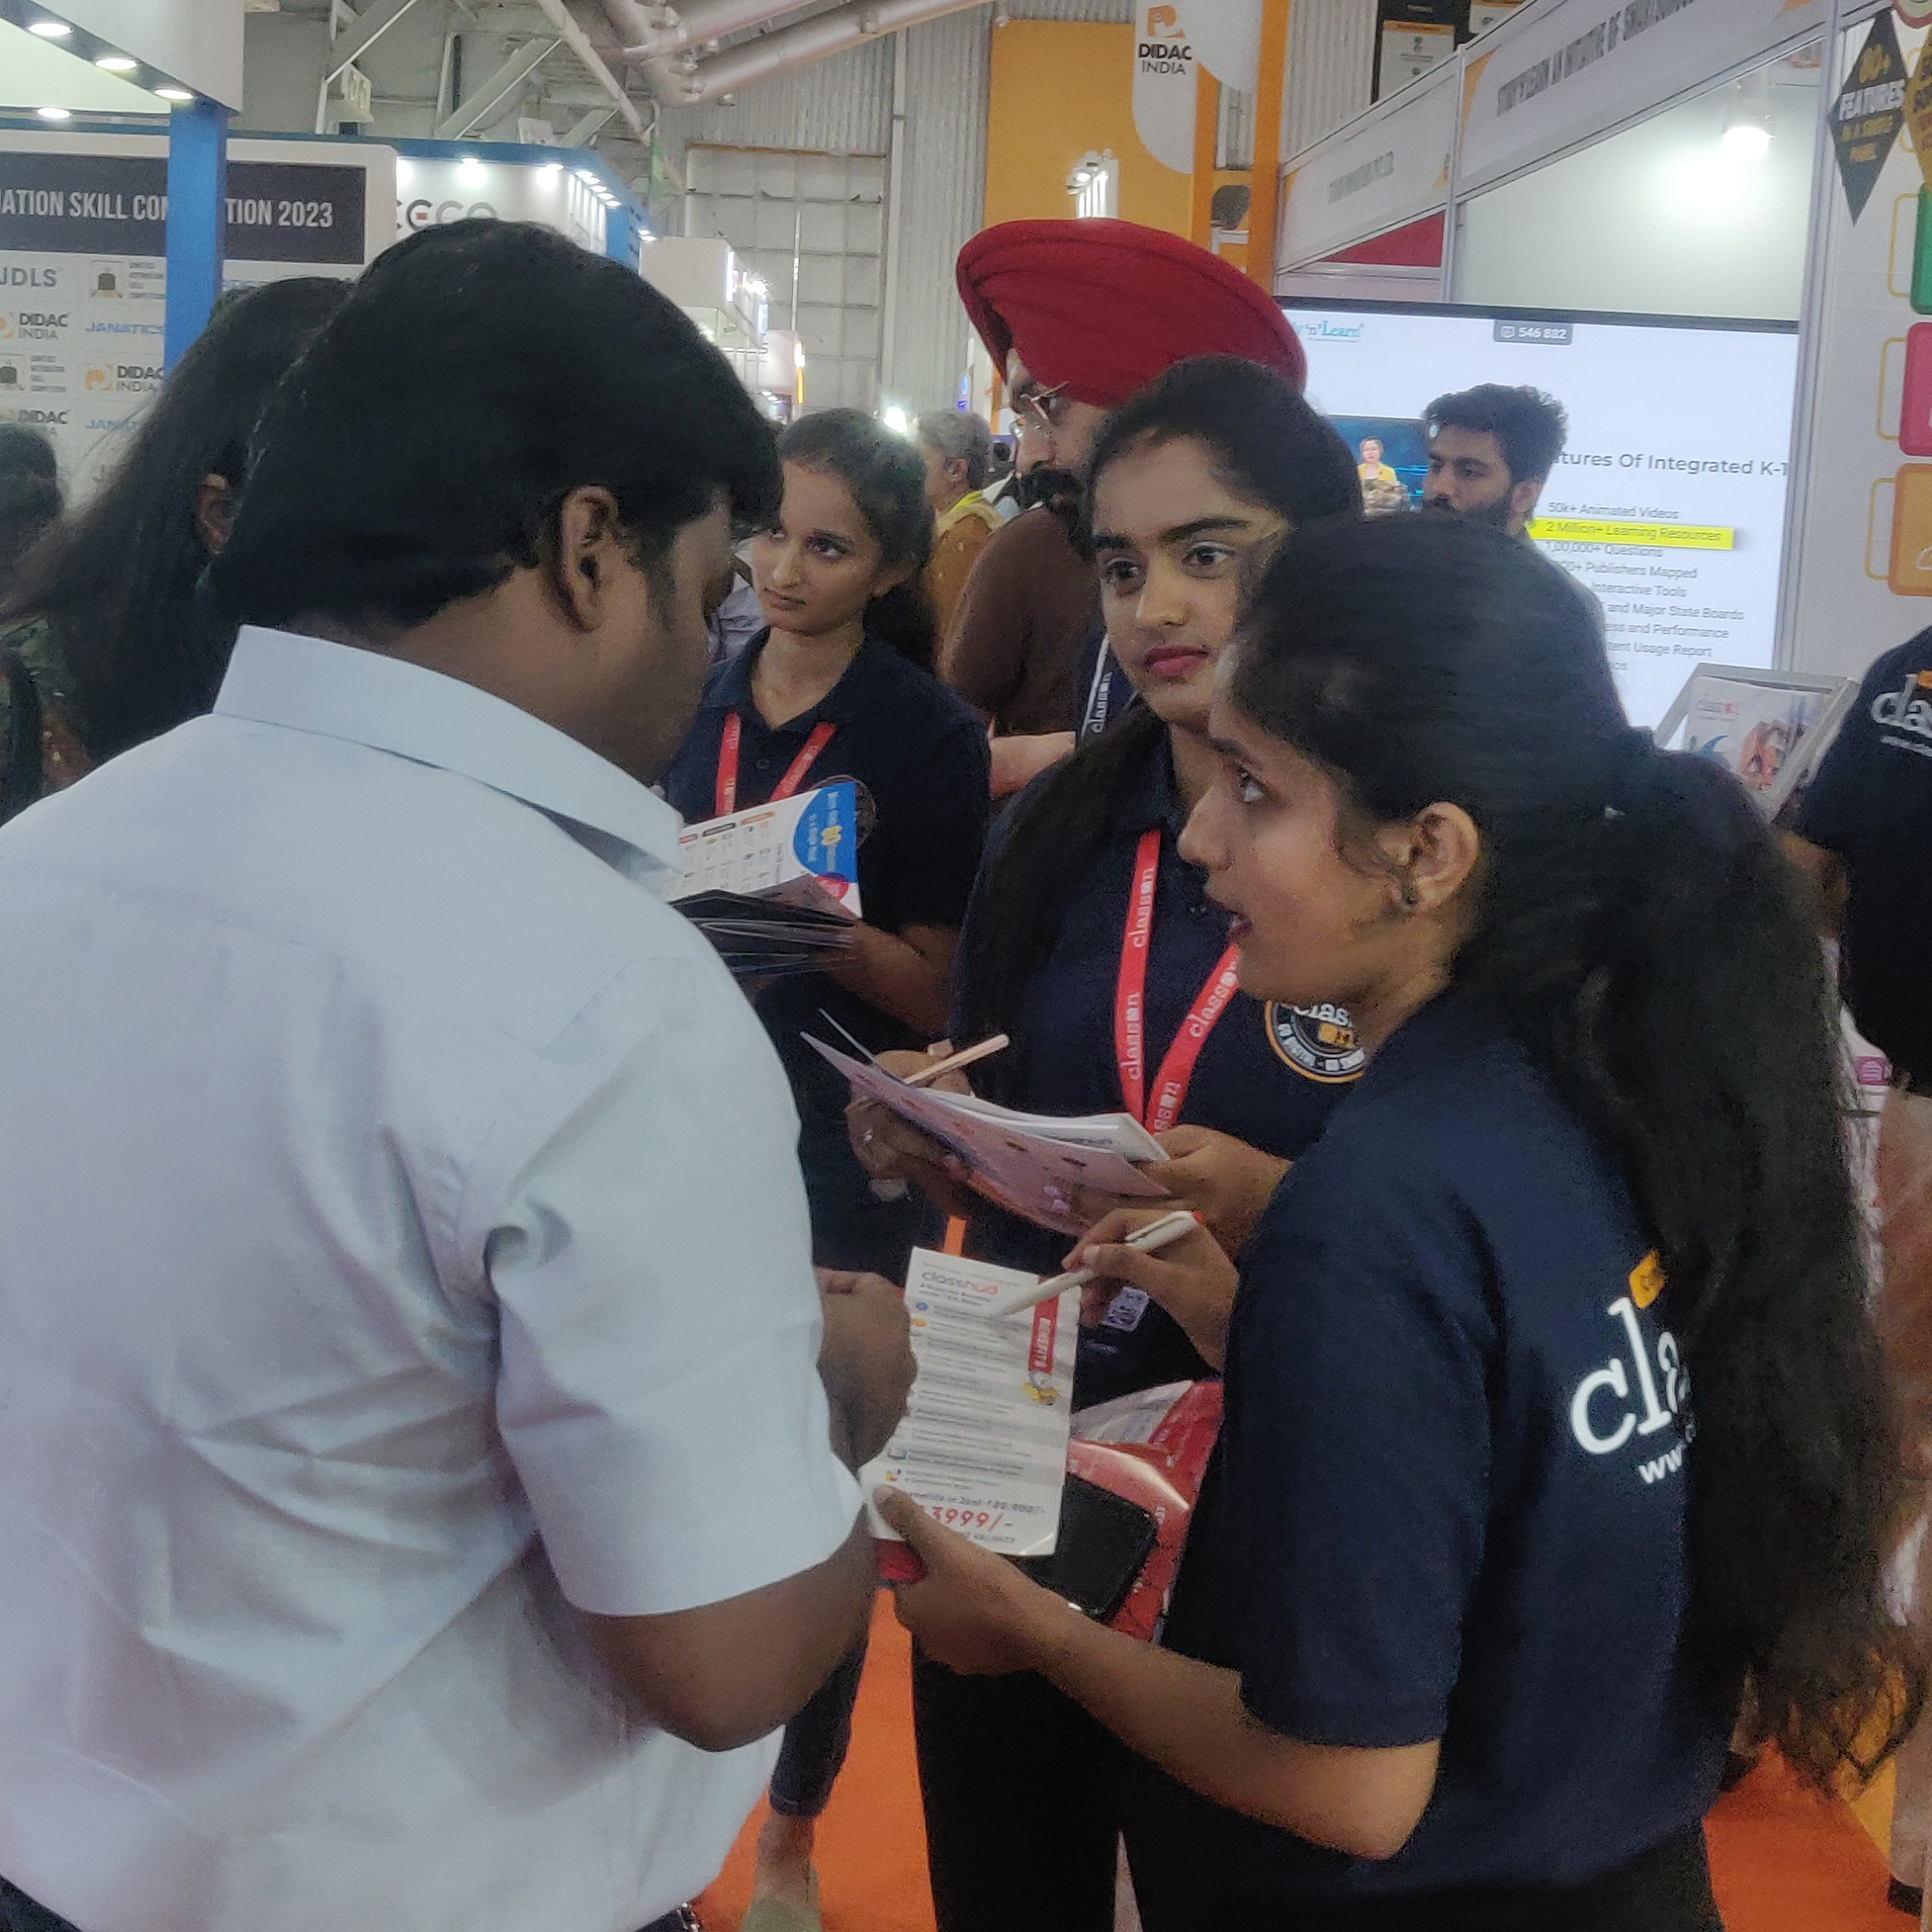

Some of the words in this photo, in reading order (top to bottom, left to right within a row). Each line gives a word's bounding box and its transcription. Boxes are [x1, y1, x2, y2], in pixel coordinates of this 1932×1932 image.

[1138, 43, 1193, 60] DIDAC
[1141, 60, 1186, 75] INDIA
[0, 188, 64, 217] ATION
[69, 191, 128, 220] SKILL
[277, 200, 333, 228] 2023
[19, 312, 70, 327] DIDAC
[1619, 453, 1643, 467] Of
[1648, 455, 1754, 475] Integrated
[1579, 504, 1637, 517] Animated
[1639, 506, 1680, 520] Videos
[1545, 521, 1554, 531] 2
[1605, 525, 1656, 540] Learning
[1659, 528, 1722, 541] Resources
[1585, 561, 1647, 576] Publishers
[1649, 565, 1698, 580] Mapped
[1655, 585, 1688, 597] Tools
[1607, 603, 1629, 614] and
[1632, 604, 1667, 617] Major
[1669, 606, 1701, 617] State
[1701, 607, 1745, 620] Boards
[1605, 623, 1626, 633] ess
[1627, 623, 1650, 634] and
[1652, 624, 1730, 639] Performance
[1634, 642, 1670, 657] Usage
[1673, 644, 1712, 658] Report
[1571, 1296, 1690, 1454] cla
